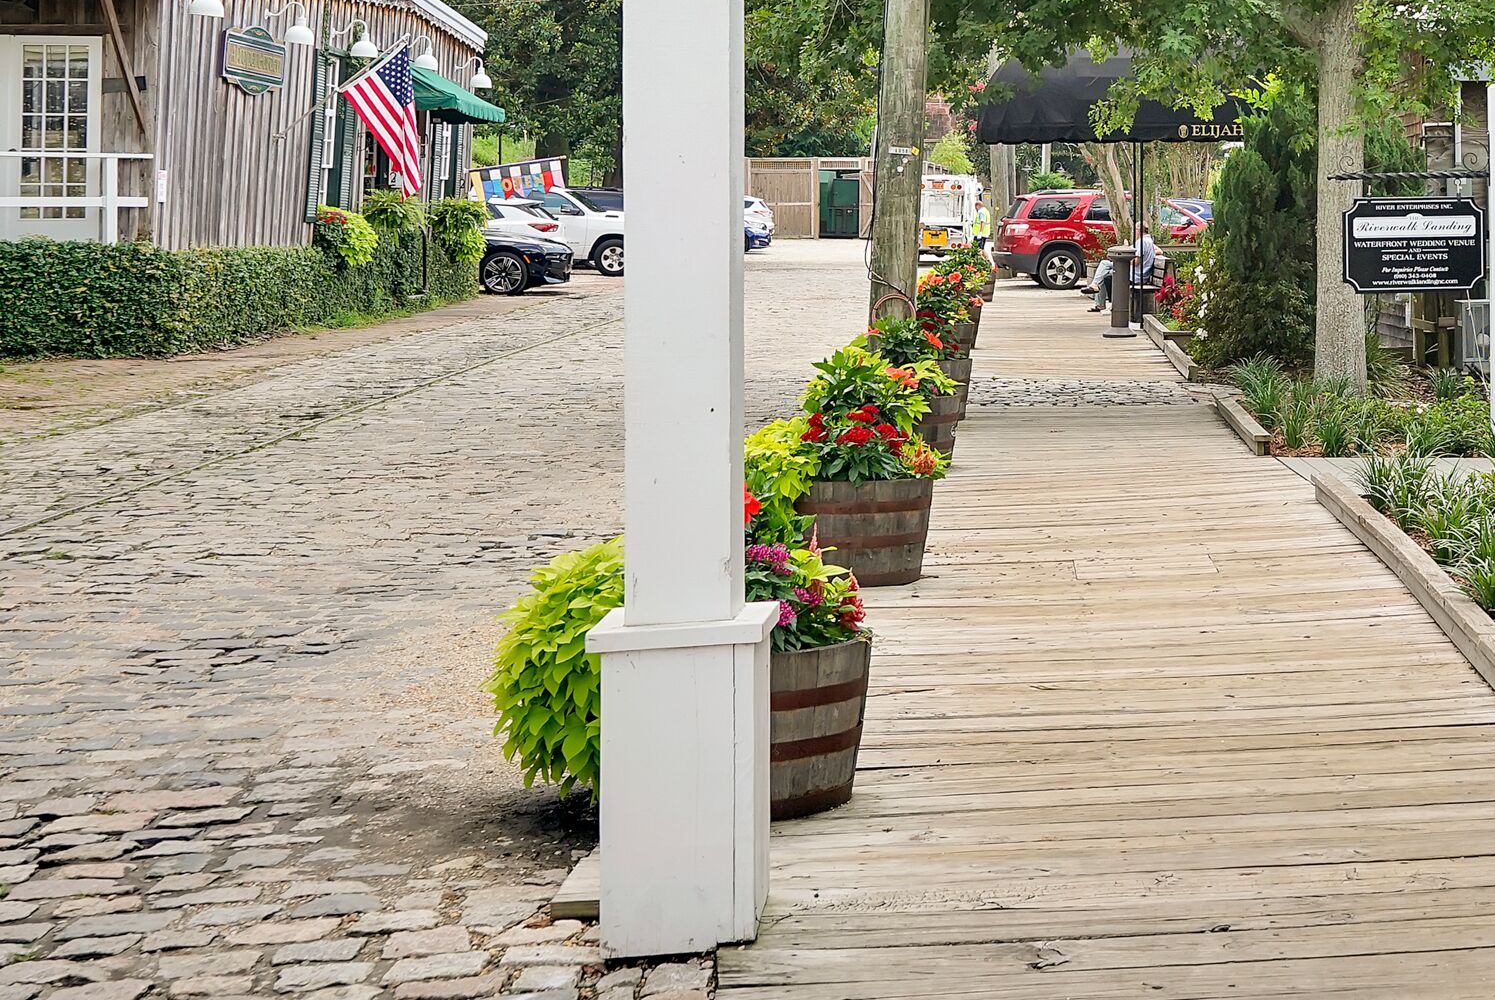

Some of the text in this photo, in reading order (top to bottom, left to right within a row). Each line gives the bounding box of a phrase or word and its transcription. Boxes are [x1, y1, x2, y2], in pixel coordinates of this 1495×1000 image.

[1191, 124, 1244, 138] ELIJAH
[1397, 203, 1440, 211] ENTERPRISES
[1356, 219, 1473, 234] Riverwalk Landing
[1354, 239, 1476, 248] WATERFRONT WEDDING VENUE
[1382, 253, 1449, 261] SPECIAL EVENTS
